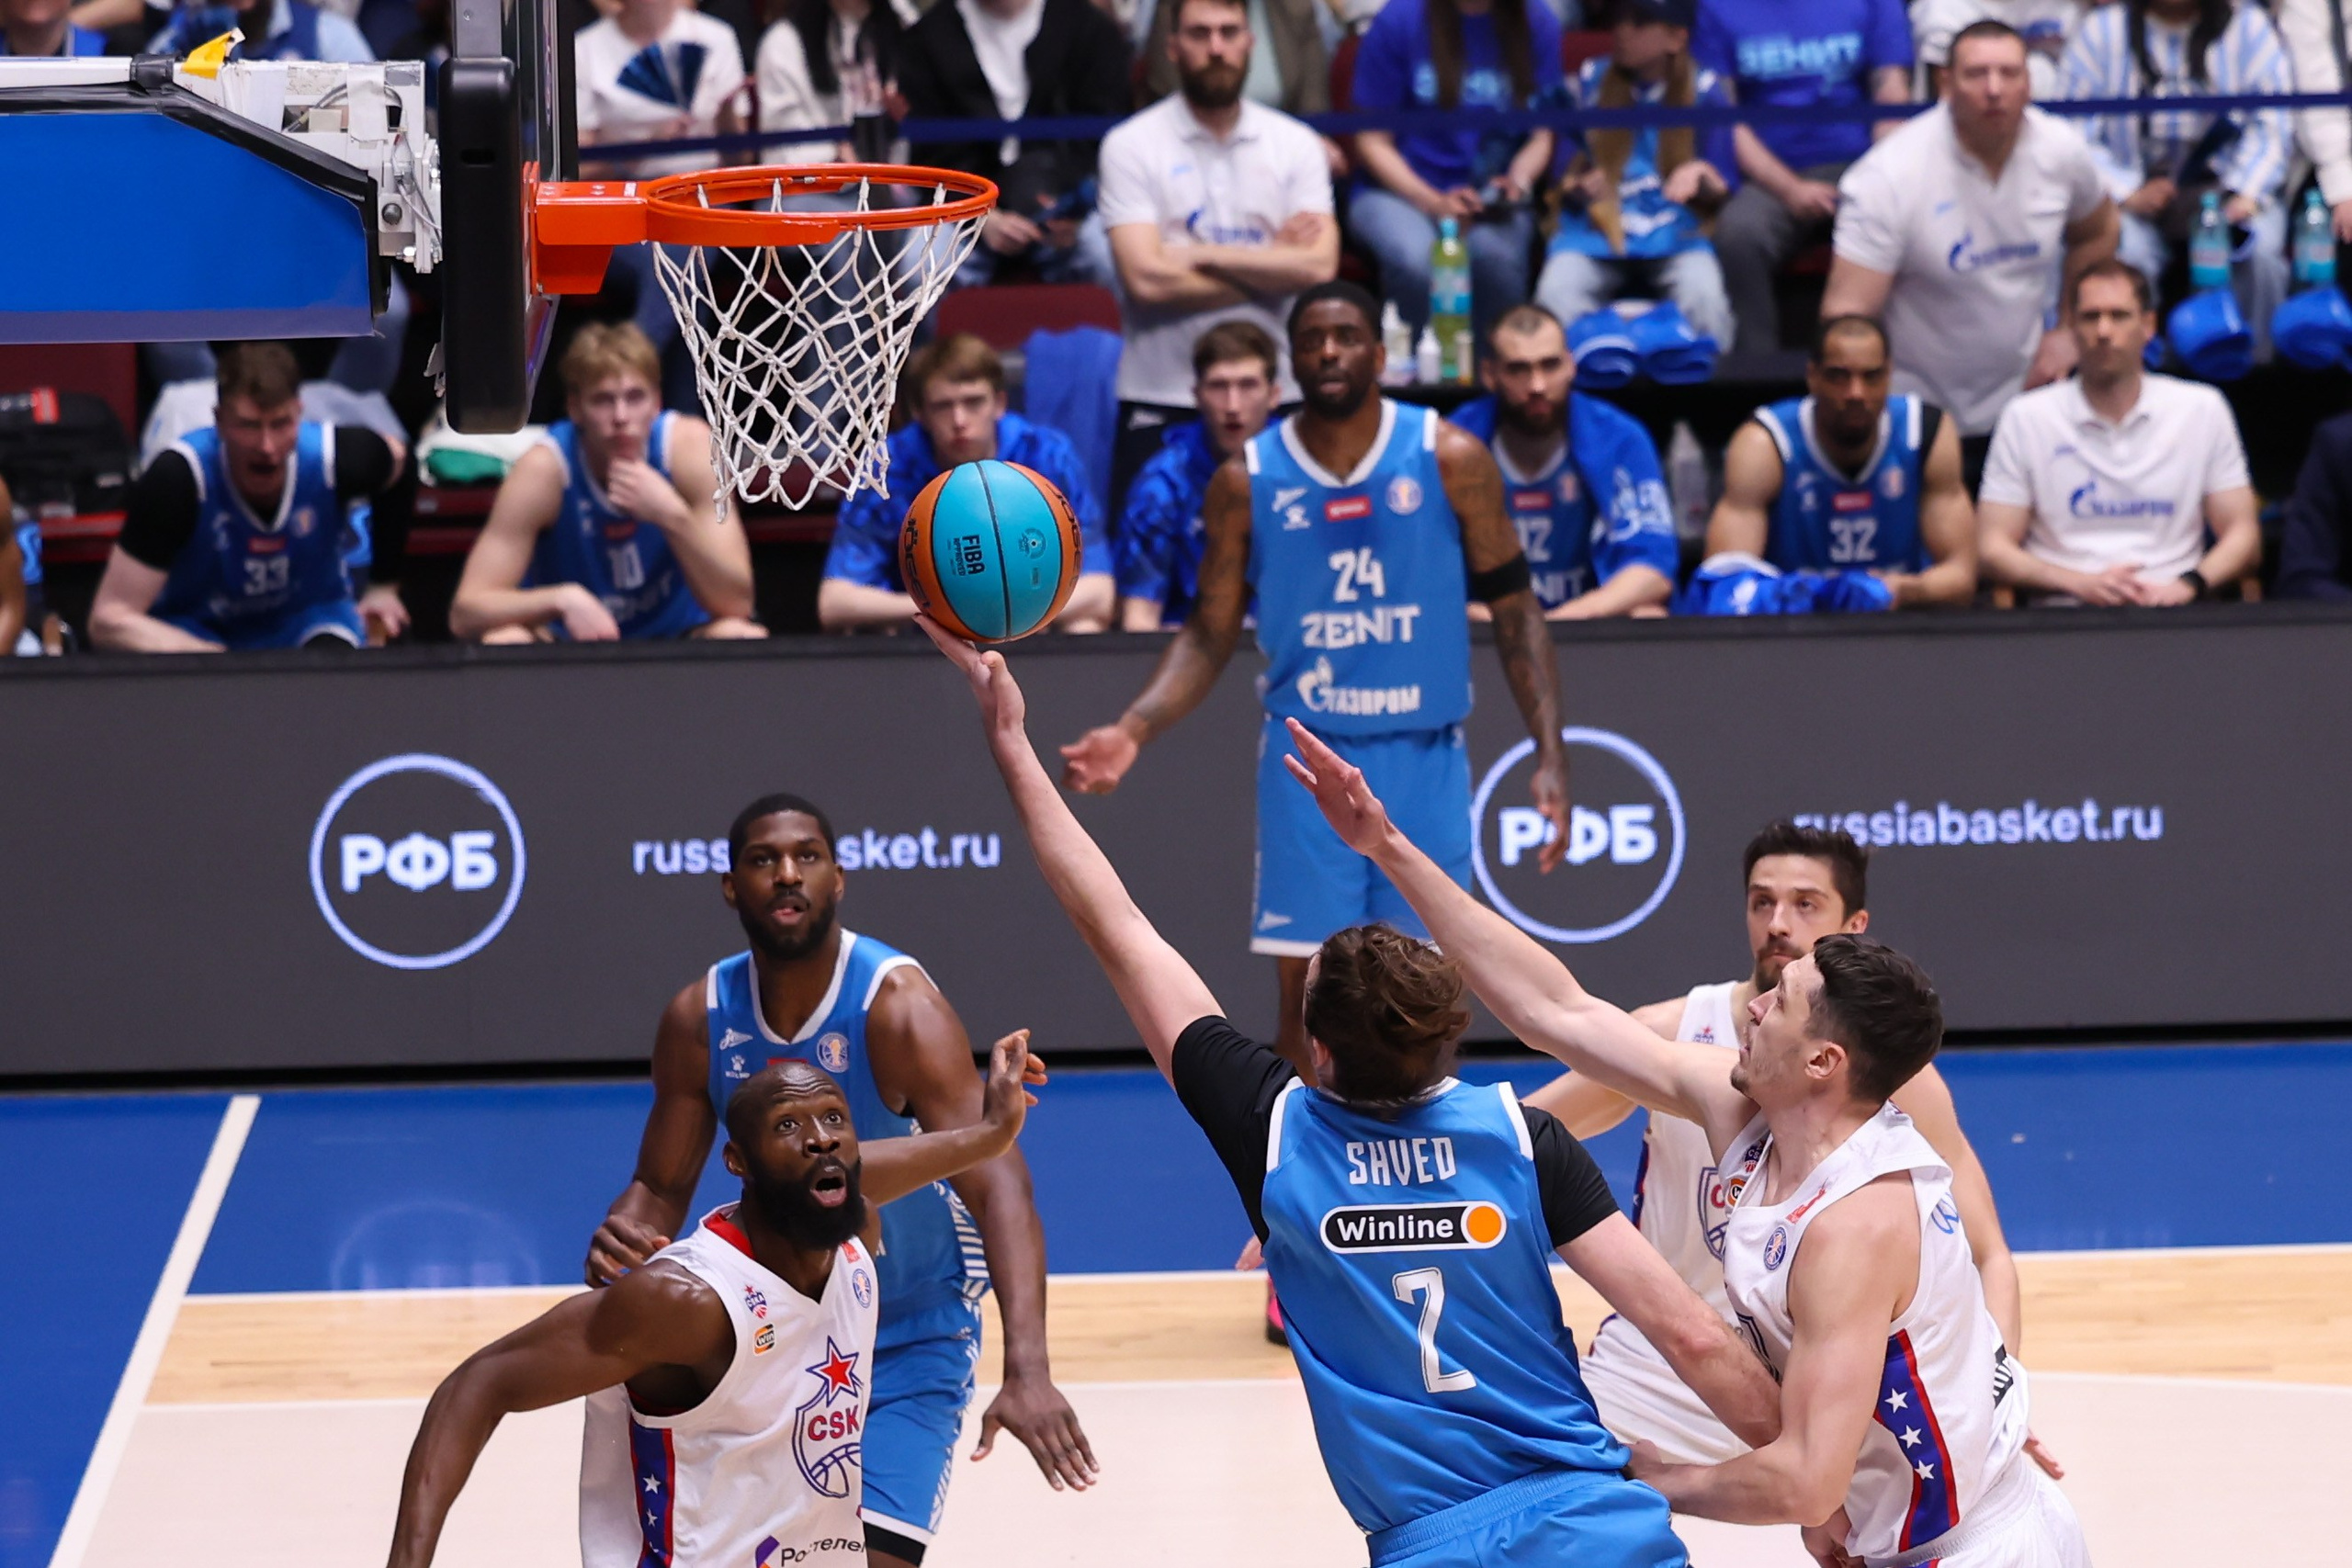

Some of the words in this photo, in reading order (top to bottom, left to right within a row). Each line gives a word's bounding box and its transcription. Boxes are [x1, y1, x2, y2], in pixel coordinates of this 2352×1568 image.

[962, 535, 986, 575] FIBA
[1830, 517, 1878, 563] 32
[243, 555, 290, 597] 33
[1329, 547, 1386, 604] 24
[1300, 603, 1422, 649] ZENIT
[340, 829, 499, 895] РФБ
[633, 825, 1001, 874] russsket.ru
[1346, 1137, 1457, 1186] SHVED
[1337, 1214, 1454, 1242] Winline
[1392, 1266, 1477, 1393] 2
[808, 1404, 860, 1441] CSK
[781, 1538, 865, 1567] Ротеле
